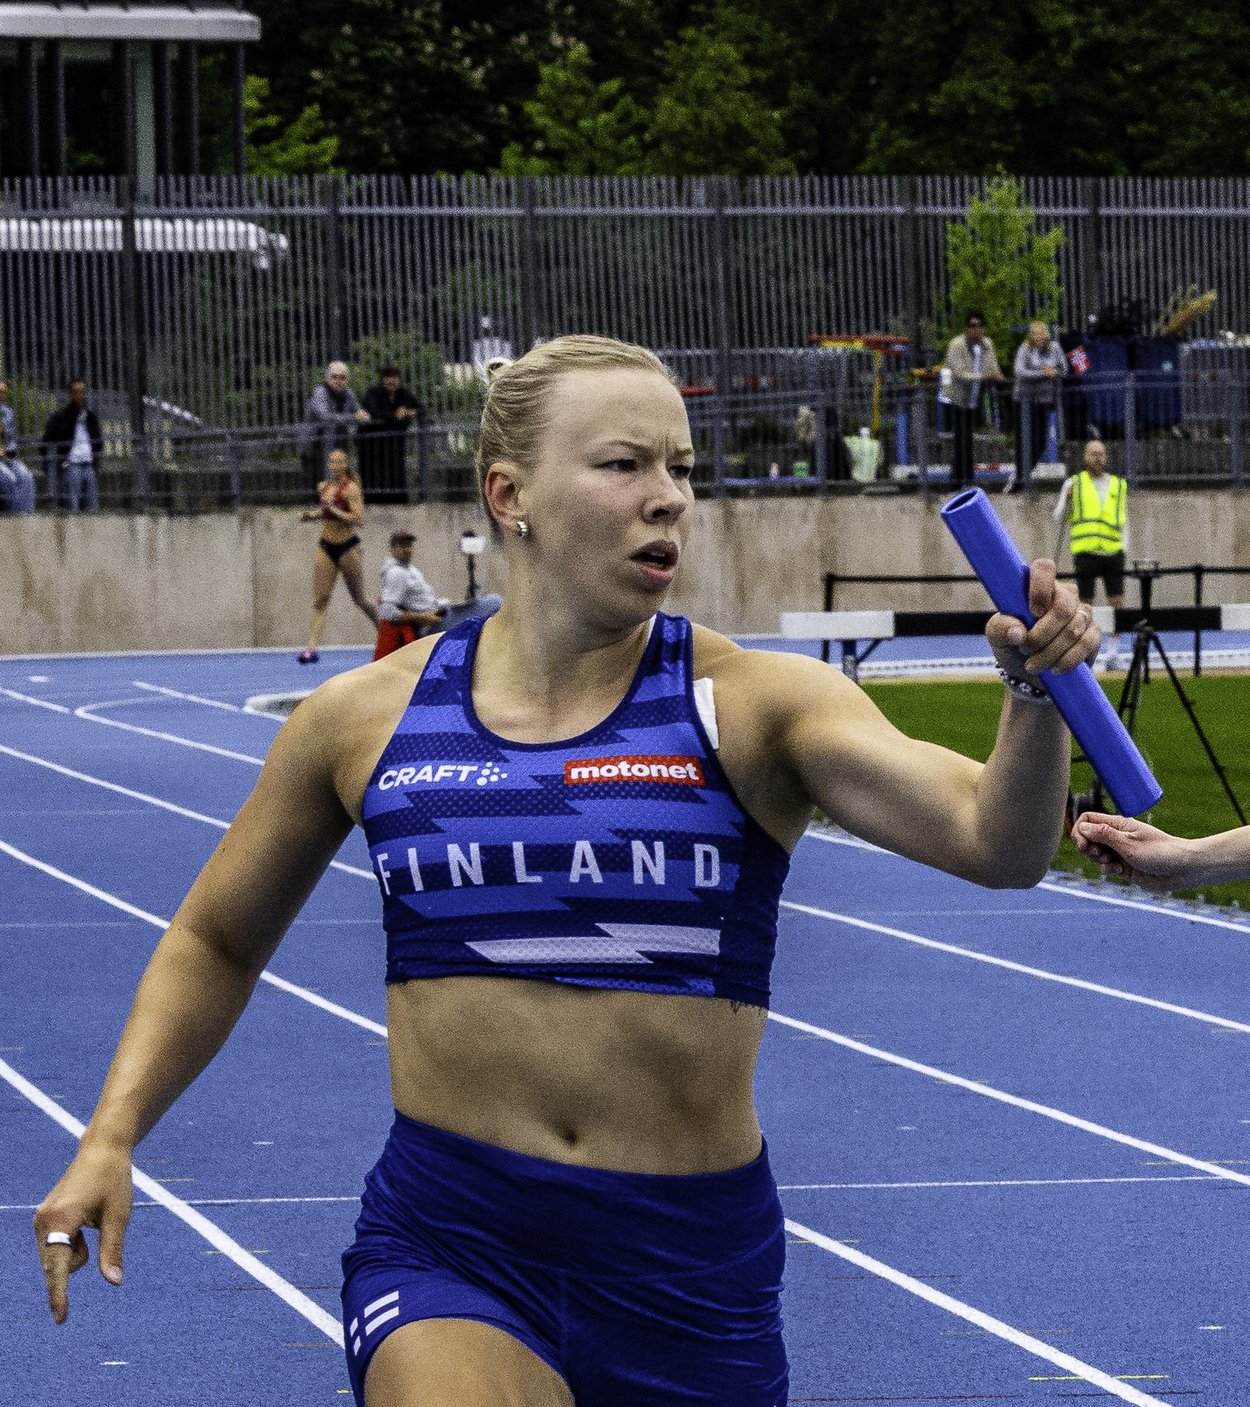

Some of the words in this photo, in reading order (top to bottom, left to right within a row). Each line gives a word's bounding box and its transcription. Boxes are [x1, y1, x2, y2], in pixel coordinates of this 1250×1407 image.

[378, 764, 479, 790] CRAFT
[570, 760, 700, 781] motonet
[376, 839, 721, 895] FINLAND
